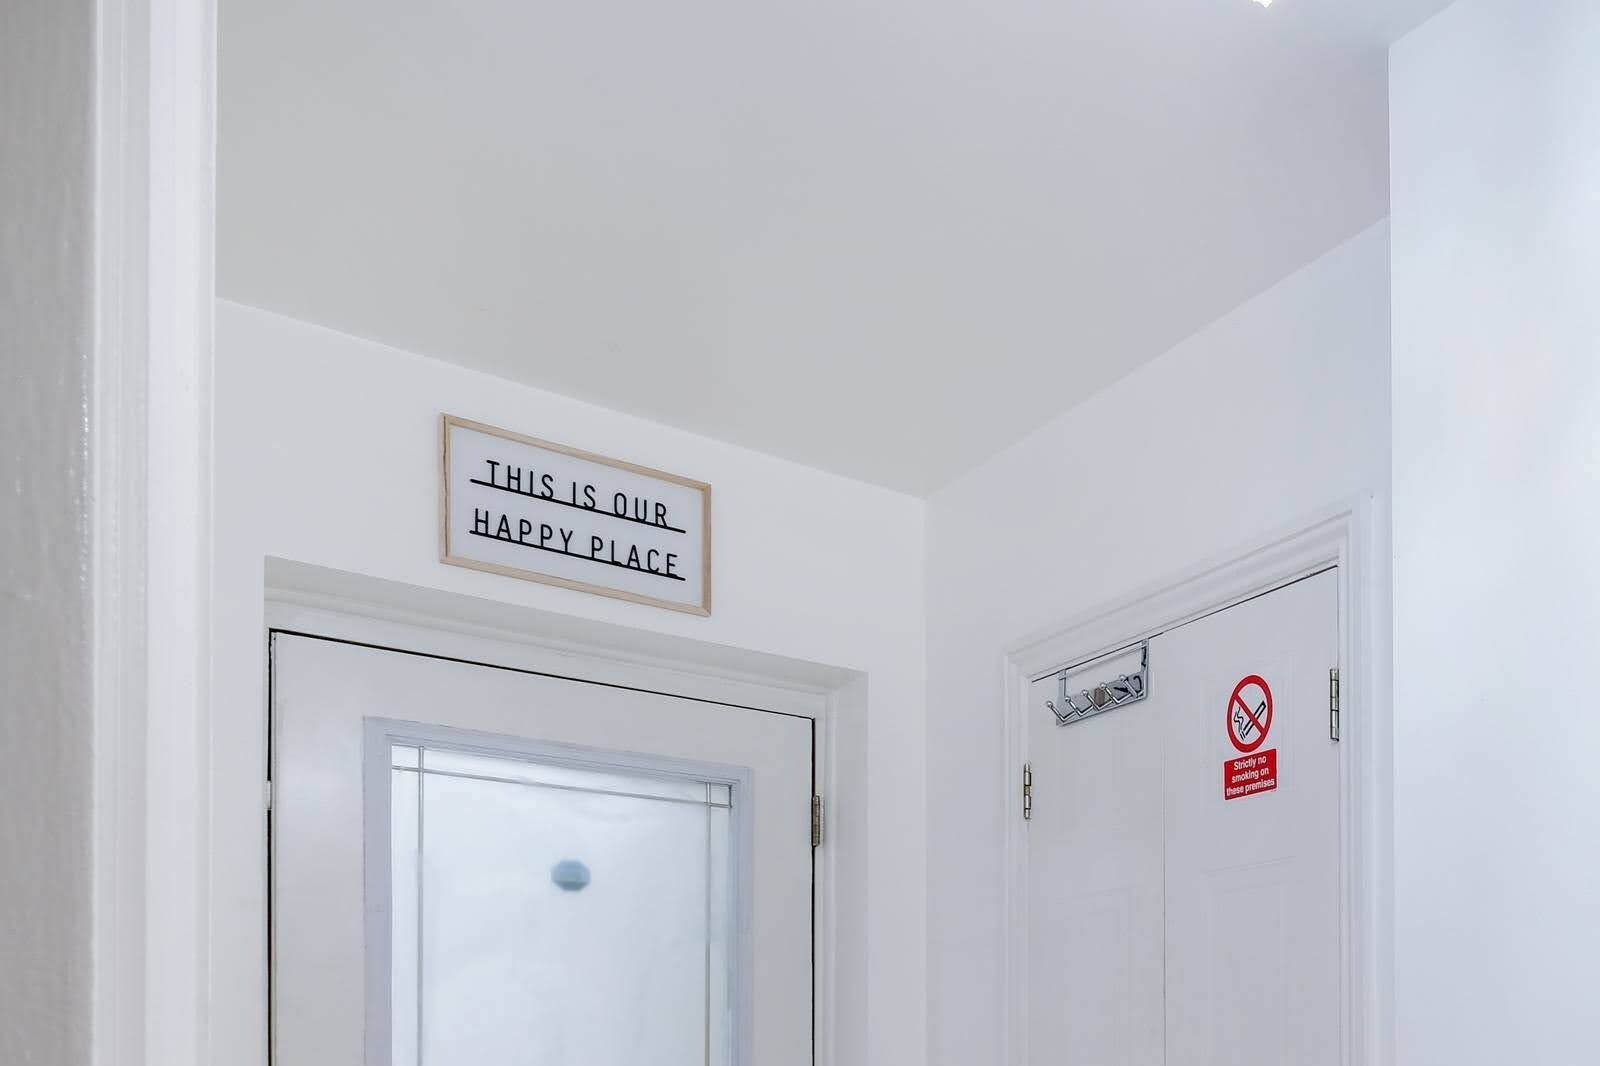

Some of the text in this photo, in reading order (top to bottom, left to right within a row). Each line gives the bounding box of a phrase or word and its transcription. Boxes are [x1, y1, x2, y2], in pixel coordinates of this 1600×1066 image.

[486, 459, 668, 528] THIS IS OUR
[474, 508, 678, 578] HAPPY PLACE
[1234, 756, 1266, 770] Strictly no
[1231, 767, 1269, 783] smoking on
[1226, 779, 1275, 797] these premises
